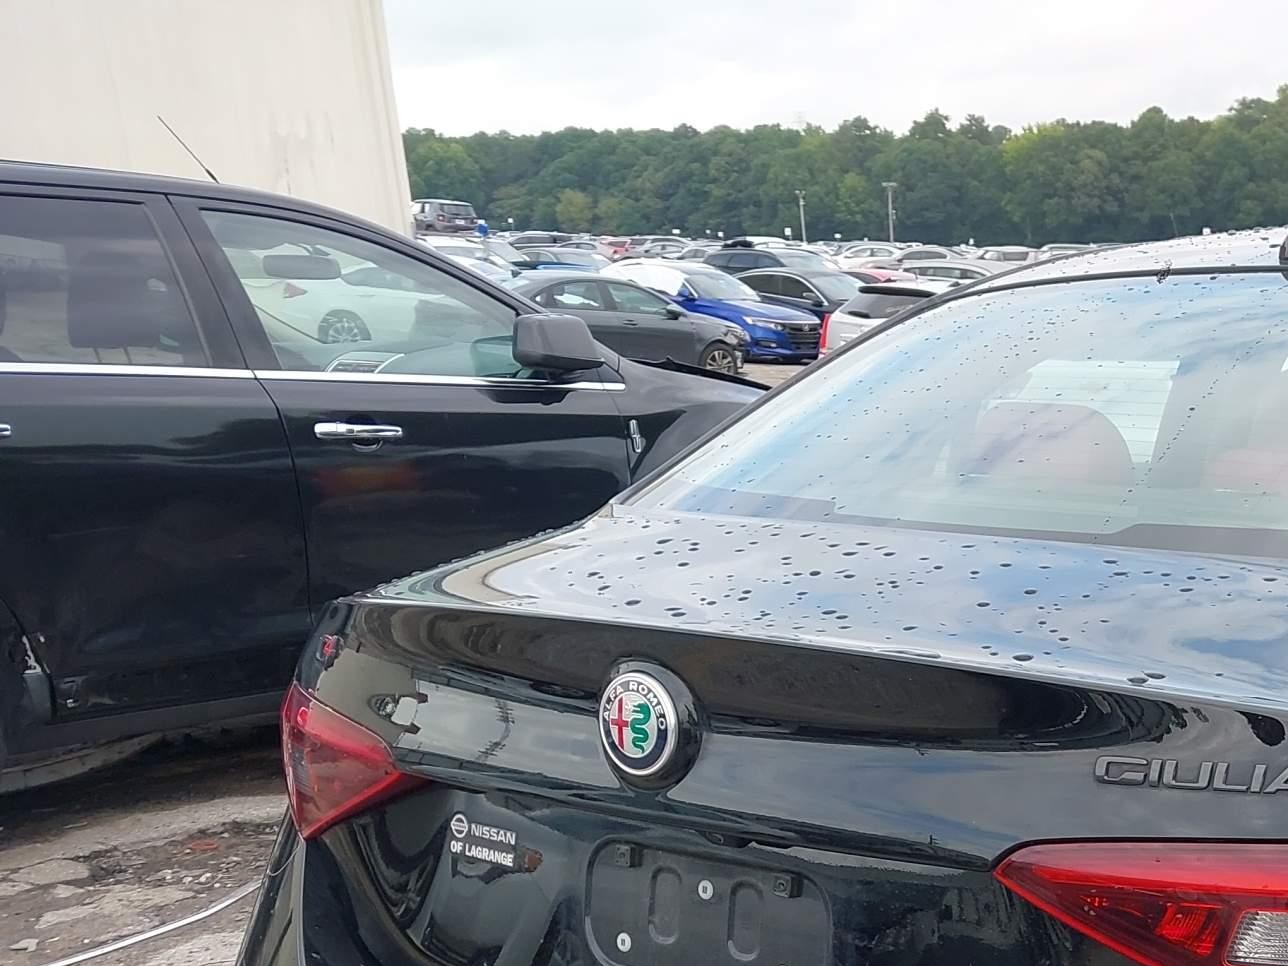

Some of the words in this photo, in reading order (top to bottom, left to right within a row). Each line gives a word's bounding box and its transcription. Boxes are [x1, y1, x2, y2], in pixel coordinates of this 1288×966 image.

[603, 684, 625, 721] ALFA
[628, 681, 667, 730] ROMEO
[470, 823, 517, 845] NISSAN
[450, 840, 464, 854] OF
[465, 843, 515, 867] LAGRANGE
